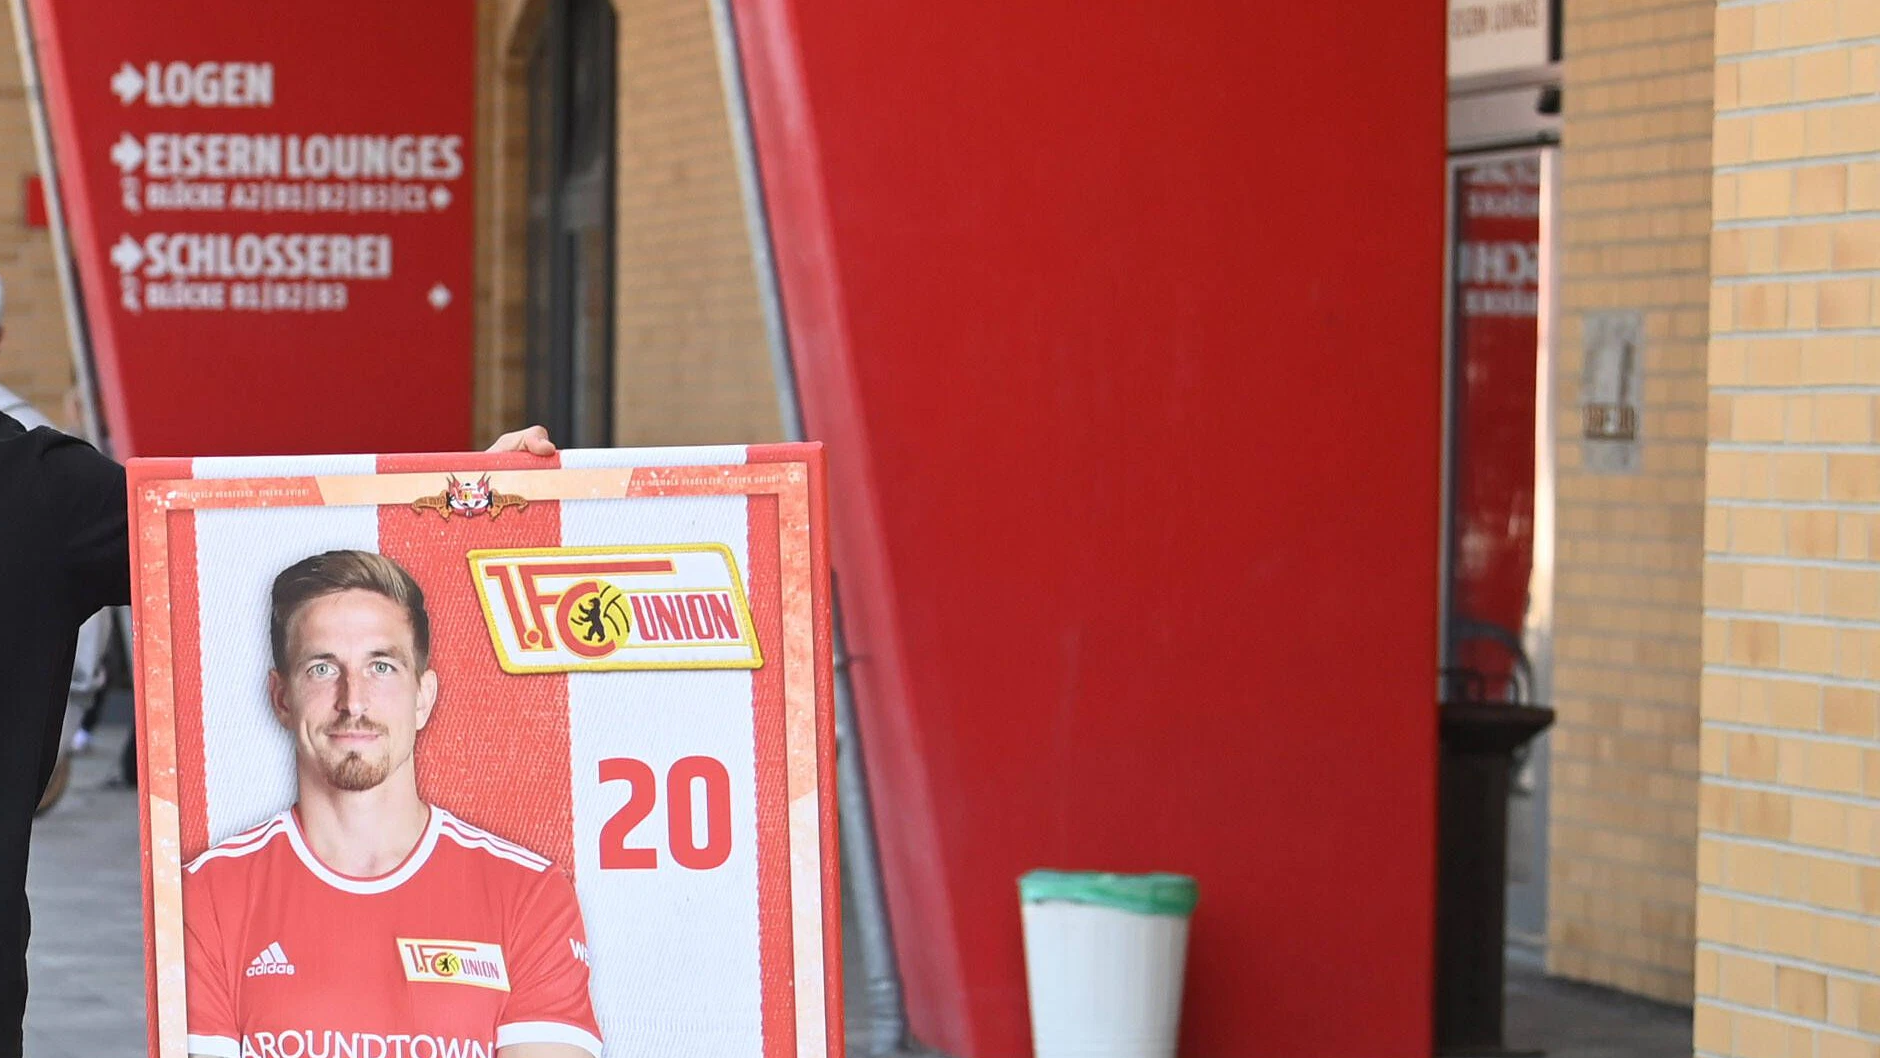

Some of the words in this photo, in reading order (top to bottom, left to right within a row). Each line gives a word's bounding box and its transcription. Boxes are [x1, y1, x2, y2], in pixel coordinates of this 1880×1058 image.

[146, 62, 275, 107] LOGEN
[145, 134, 282, 177] EISERN
[287, 135, 464, 179] LOUNGES
[144, 234, 392, 278] SCHLOSSEREI
[630, 593, 740, 641] UNION
[598, 755, 732, 870] 20
[246, 962, 295, 978] adidas
[460, 957, 501, 981] UNION
